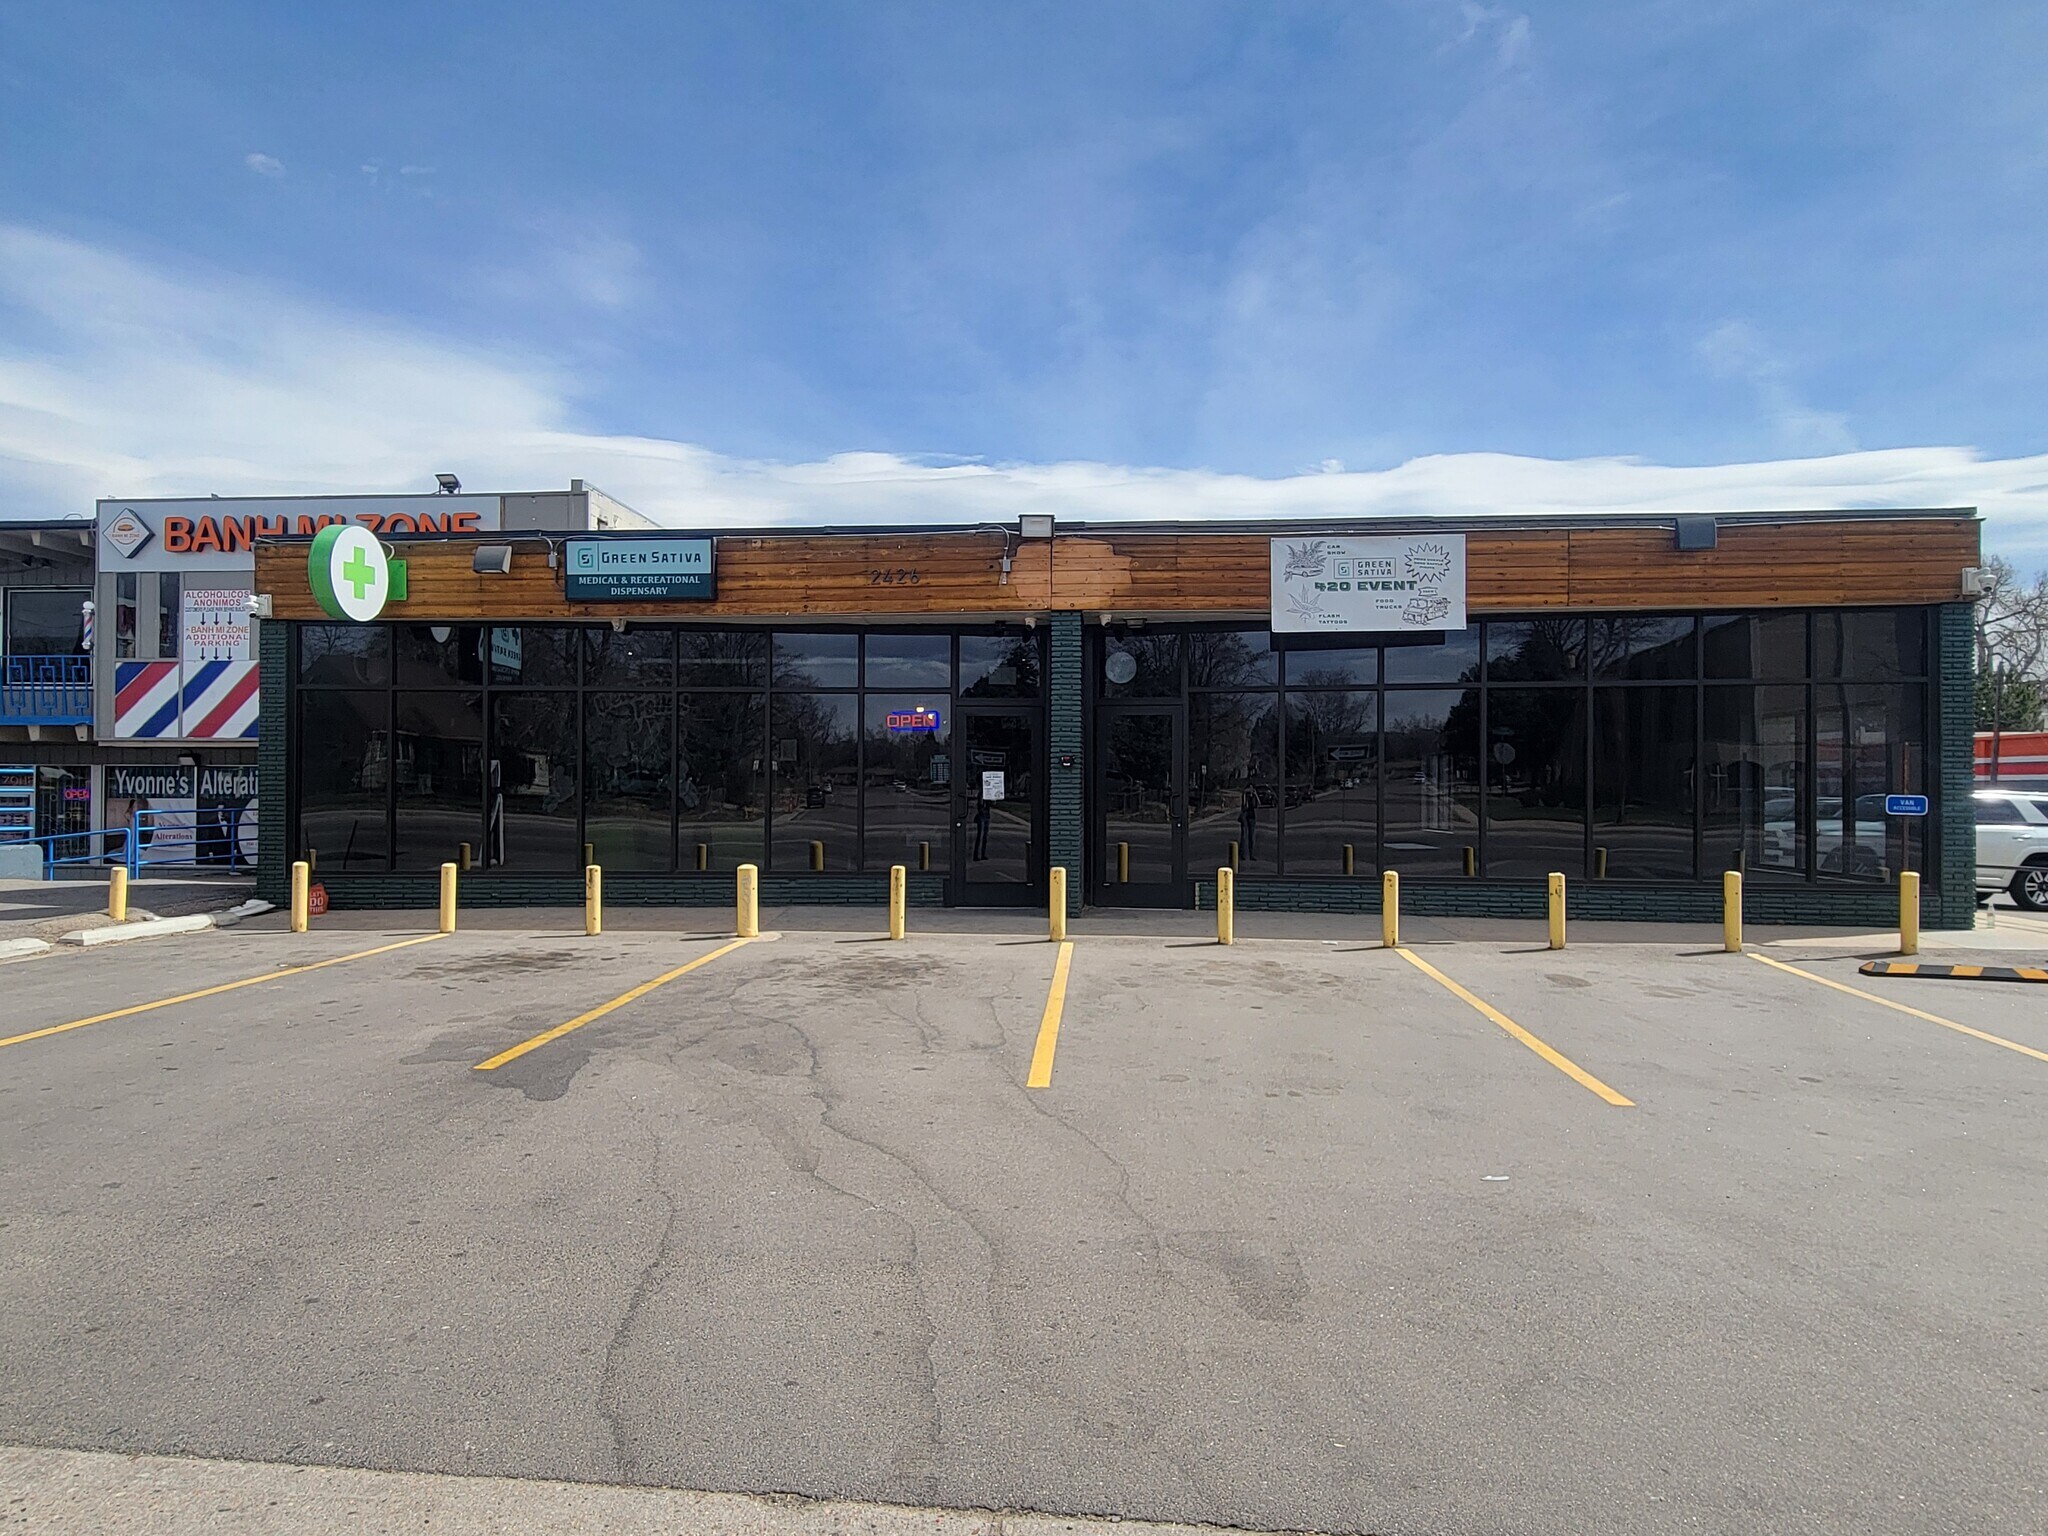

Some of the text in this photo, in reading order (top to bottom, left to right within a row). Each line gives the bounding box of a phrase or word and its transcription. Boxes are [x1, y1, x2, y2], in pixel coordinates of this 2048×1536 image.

[164, 514, 284, 551] BANH
[601, 551, 702, 564] GREEN SATIVA
[1357, 560, 1392, 568] GREEN
[871, 567, 920, 585] 2426
[1357, 568, 1392, 576] SATIVA
[578, 575, 701, 585] MEDICAL & RECREATIONAL
[610, 586, 668, 595] DISPENSARY
[1314, 580, 1418, 592] 420 EVENT
[185, 590, 250, 599] ALCOHOLICOS
[193, 598, 242, 607] ANONIMOS
[191, 626, 249, 634] BANH MI ZONE
[886, 714, 936, 728] OPEN
[115, 769, 190, 795] Yvonne's
[154, 831, 193, 841] Alterations
